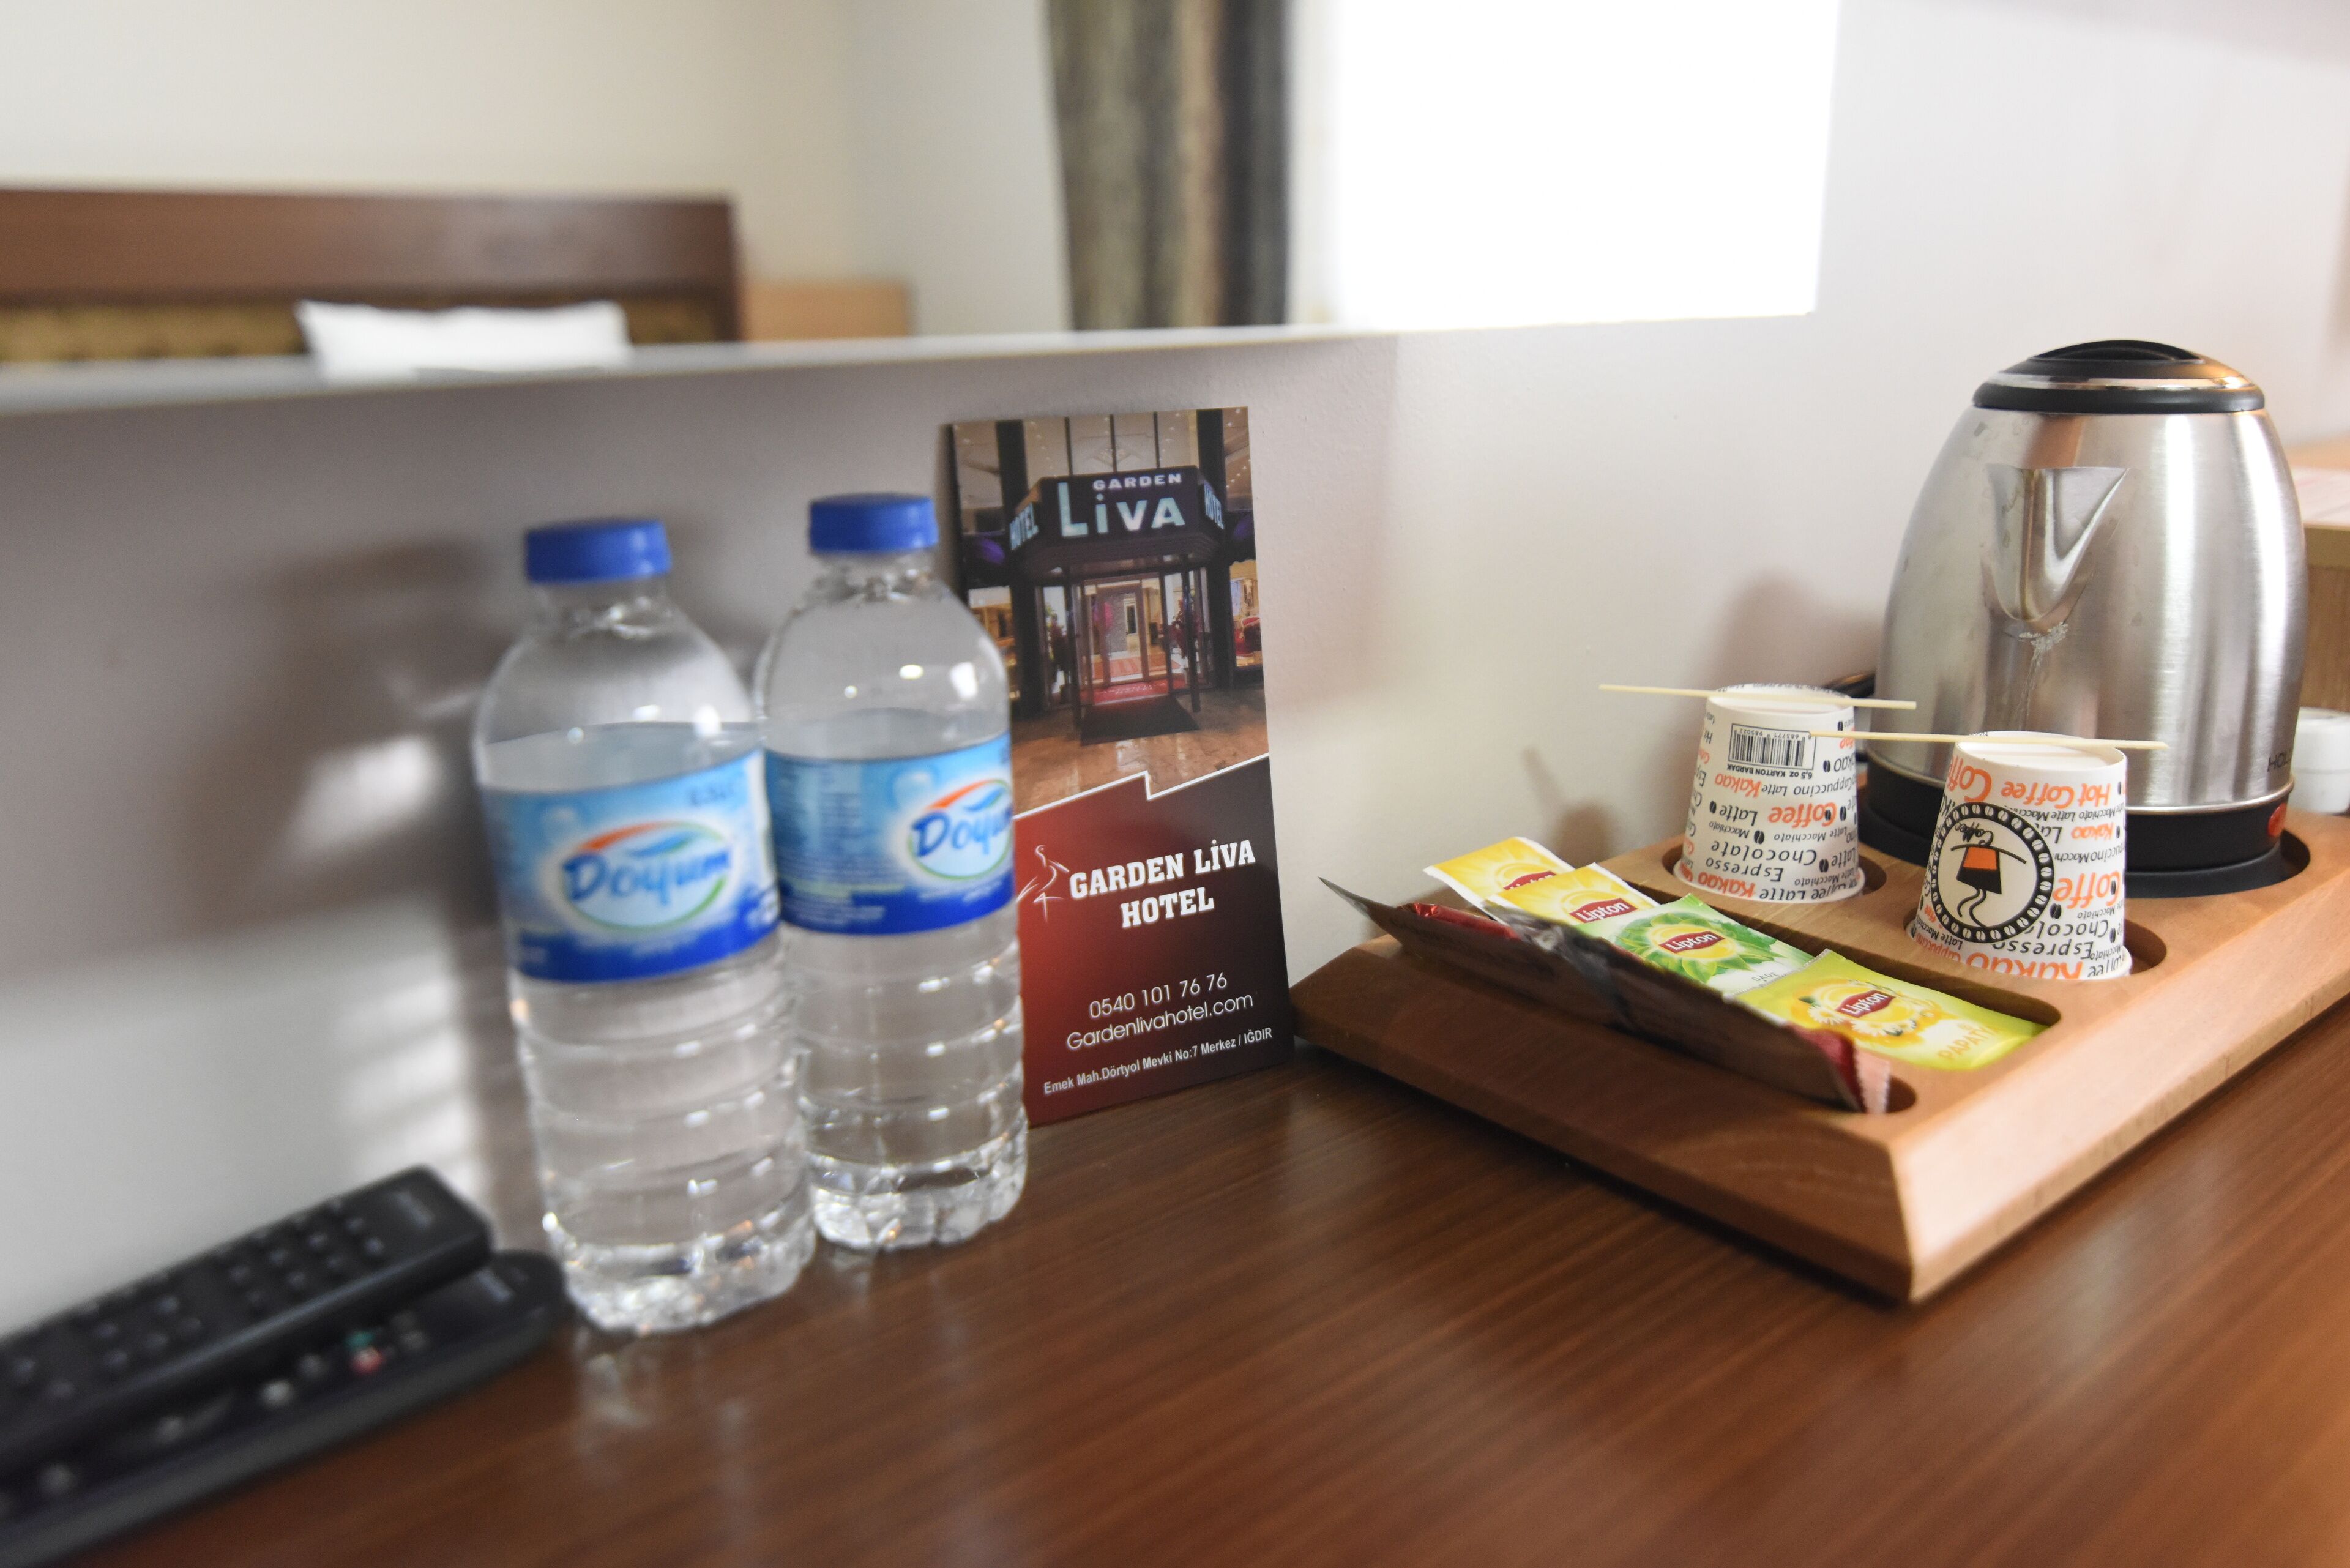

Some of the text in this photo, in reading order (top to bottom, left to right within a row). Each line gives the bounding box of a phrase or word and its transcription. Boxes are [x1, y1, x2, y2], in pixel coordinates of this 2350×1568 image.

[1092, 473, 1182, 490] GARDEN
[1726, 763, 1755, 775] BARDAK
[1755, 768, 1786, 778] KARTON
[1800, 770, 1813, 779] 6,5
[1714, 773, 1762, 799] Kakao
[1761, 784, 1788, 797] Latte
[2000, 780, 2075, 810] Coffee
[2077, 783, 2111, 808] Hot
[1719, 805, 1758, 827] Latte
[1767, 802, 1837, 829] Coffee
[2050, 810, 2076, 822] Latte
[2078, 808, 2116, 821] Macchiato
[1709, 820, 1750, 839] Macchiato
[1774, 832, 1827, 843] Macchiato
[1711, 840, 1818, 865] Chocolate
[1070, 853, 1185, 898] GARDEN
[1705, 857, 1784, 882] Espresso
[1697, 871, 1756, 898] Kakao
[1794, 875, 1840, 887] Macchiato
[1759, 887, 1806, 901] Latte
[1120, 886, 1215, 928] HOTEL
[1576, 900, 1630, 923] Lipton
[2077, 905, 2115, 919] Macchiato
[1665, 932, 1719, 951] Lipton
[1940, 933, 1963, 950] Latte
[1089, 971, 1228, 1018] 0540 101 76 76
[1840, 991, 1888, 1015] Lipton
[1066, 994, 1253, 1050] Gardenlivahotel.com
[1043, 1077, 1075, 1095] Emek
[1142, 1051, 1173, 1069] Mevki
[1174, 1045, 1198, 1061] No:7
[1200, 1037, 1236, 1055] Merkez
[1244, 1026, 1273, 1045] IĞDIR
